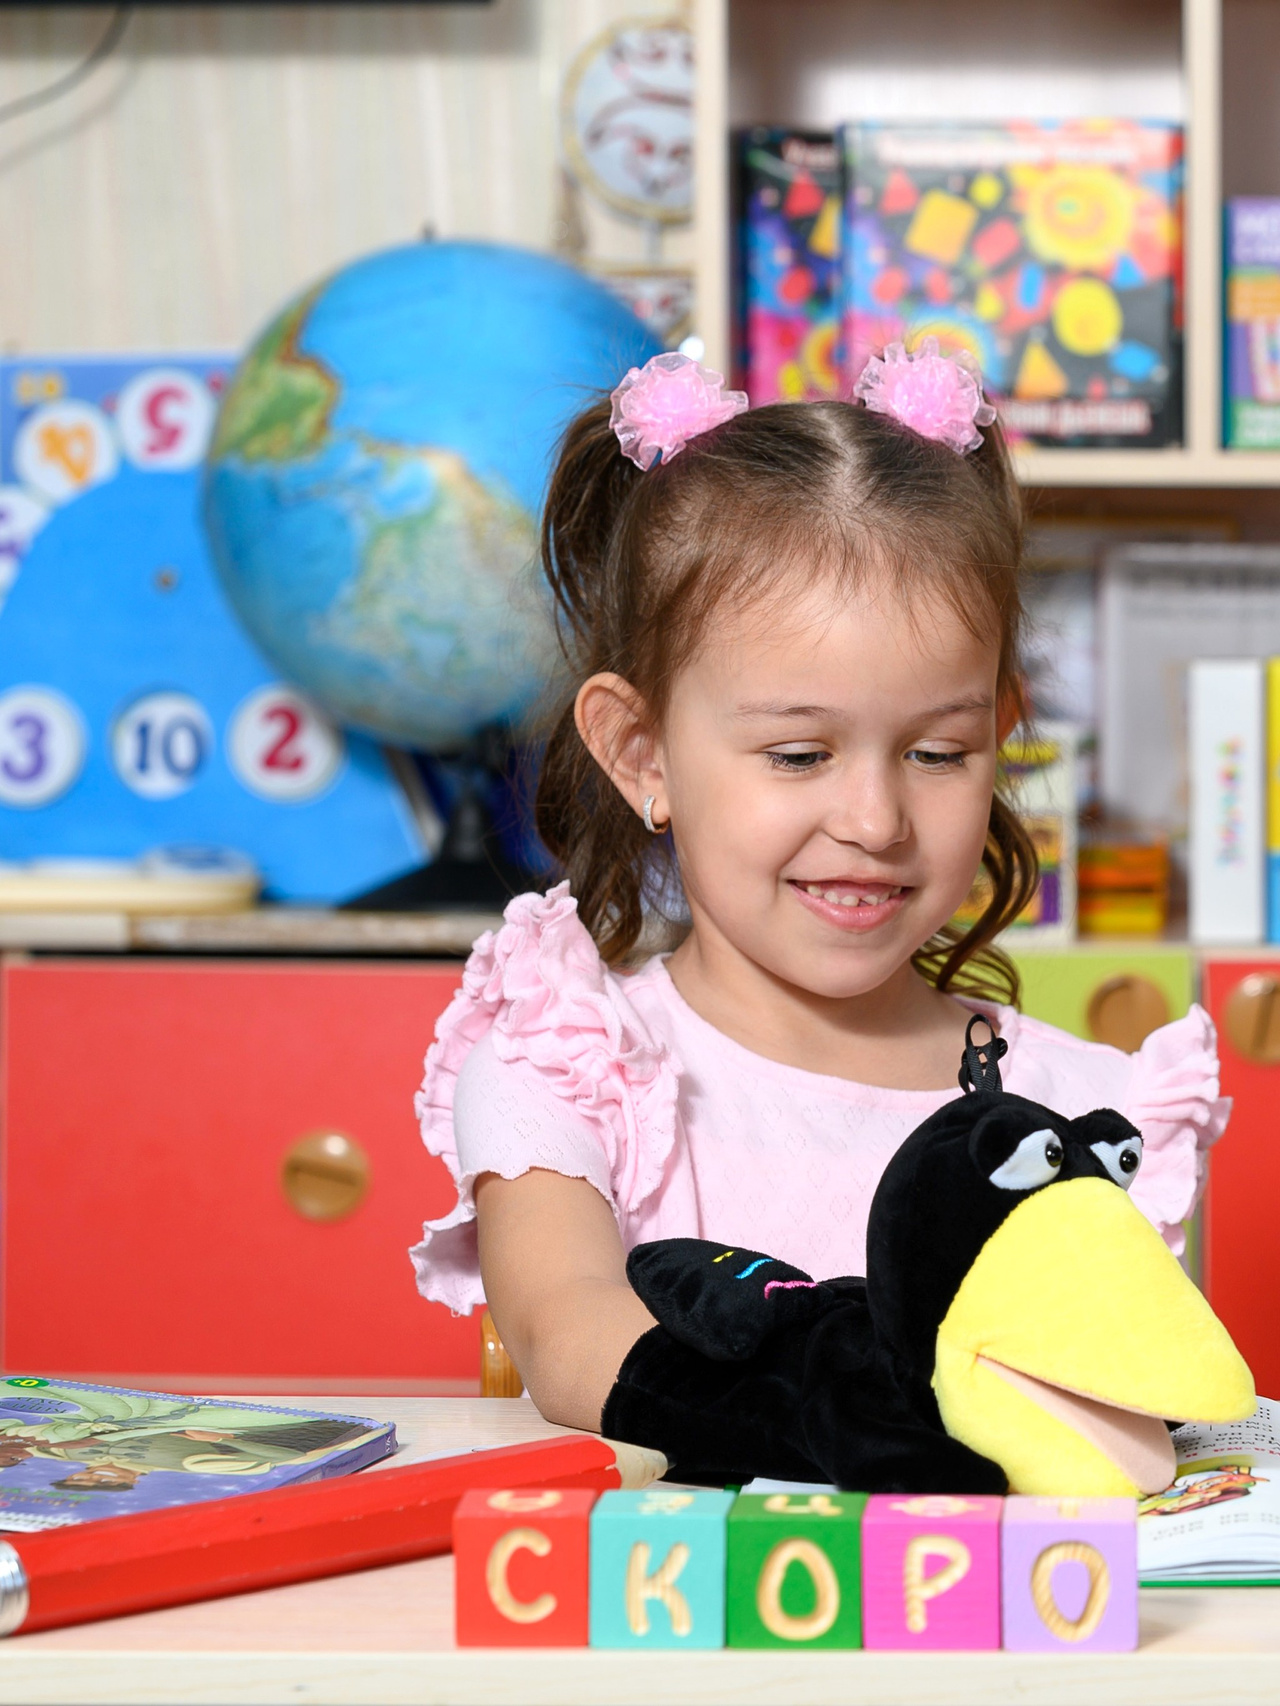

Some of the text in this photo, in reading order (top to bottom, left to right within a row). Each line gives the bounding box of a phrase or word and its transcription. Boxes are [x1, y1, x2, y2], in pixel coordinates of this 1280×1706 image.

[2, 713, 47, 784] 3
[134, 714, 203, 778] 10
[261, 706, 307, 774] 2
[486, 1526, 1111, 1644] СКОРО
